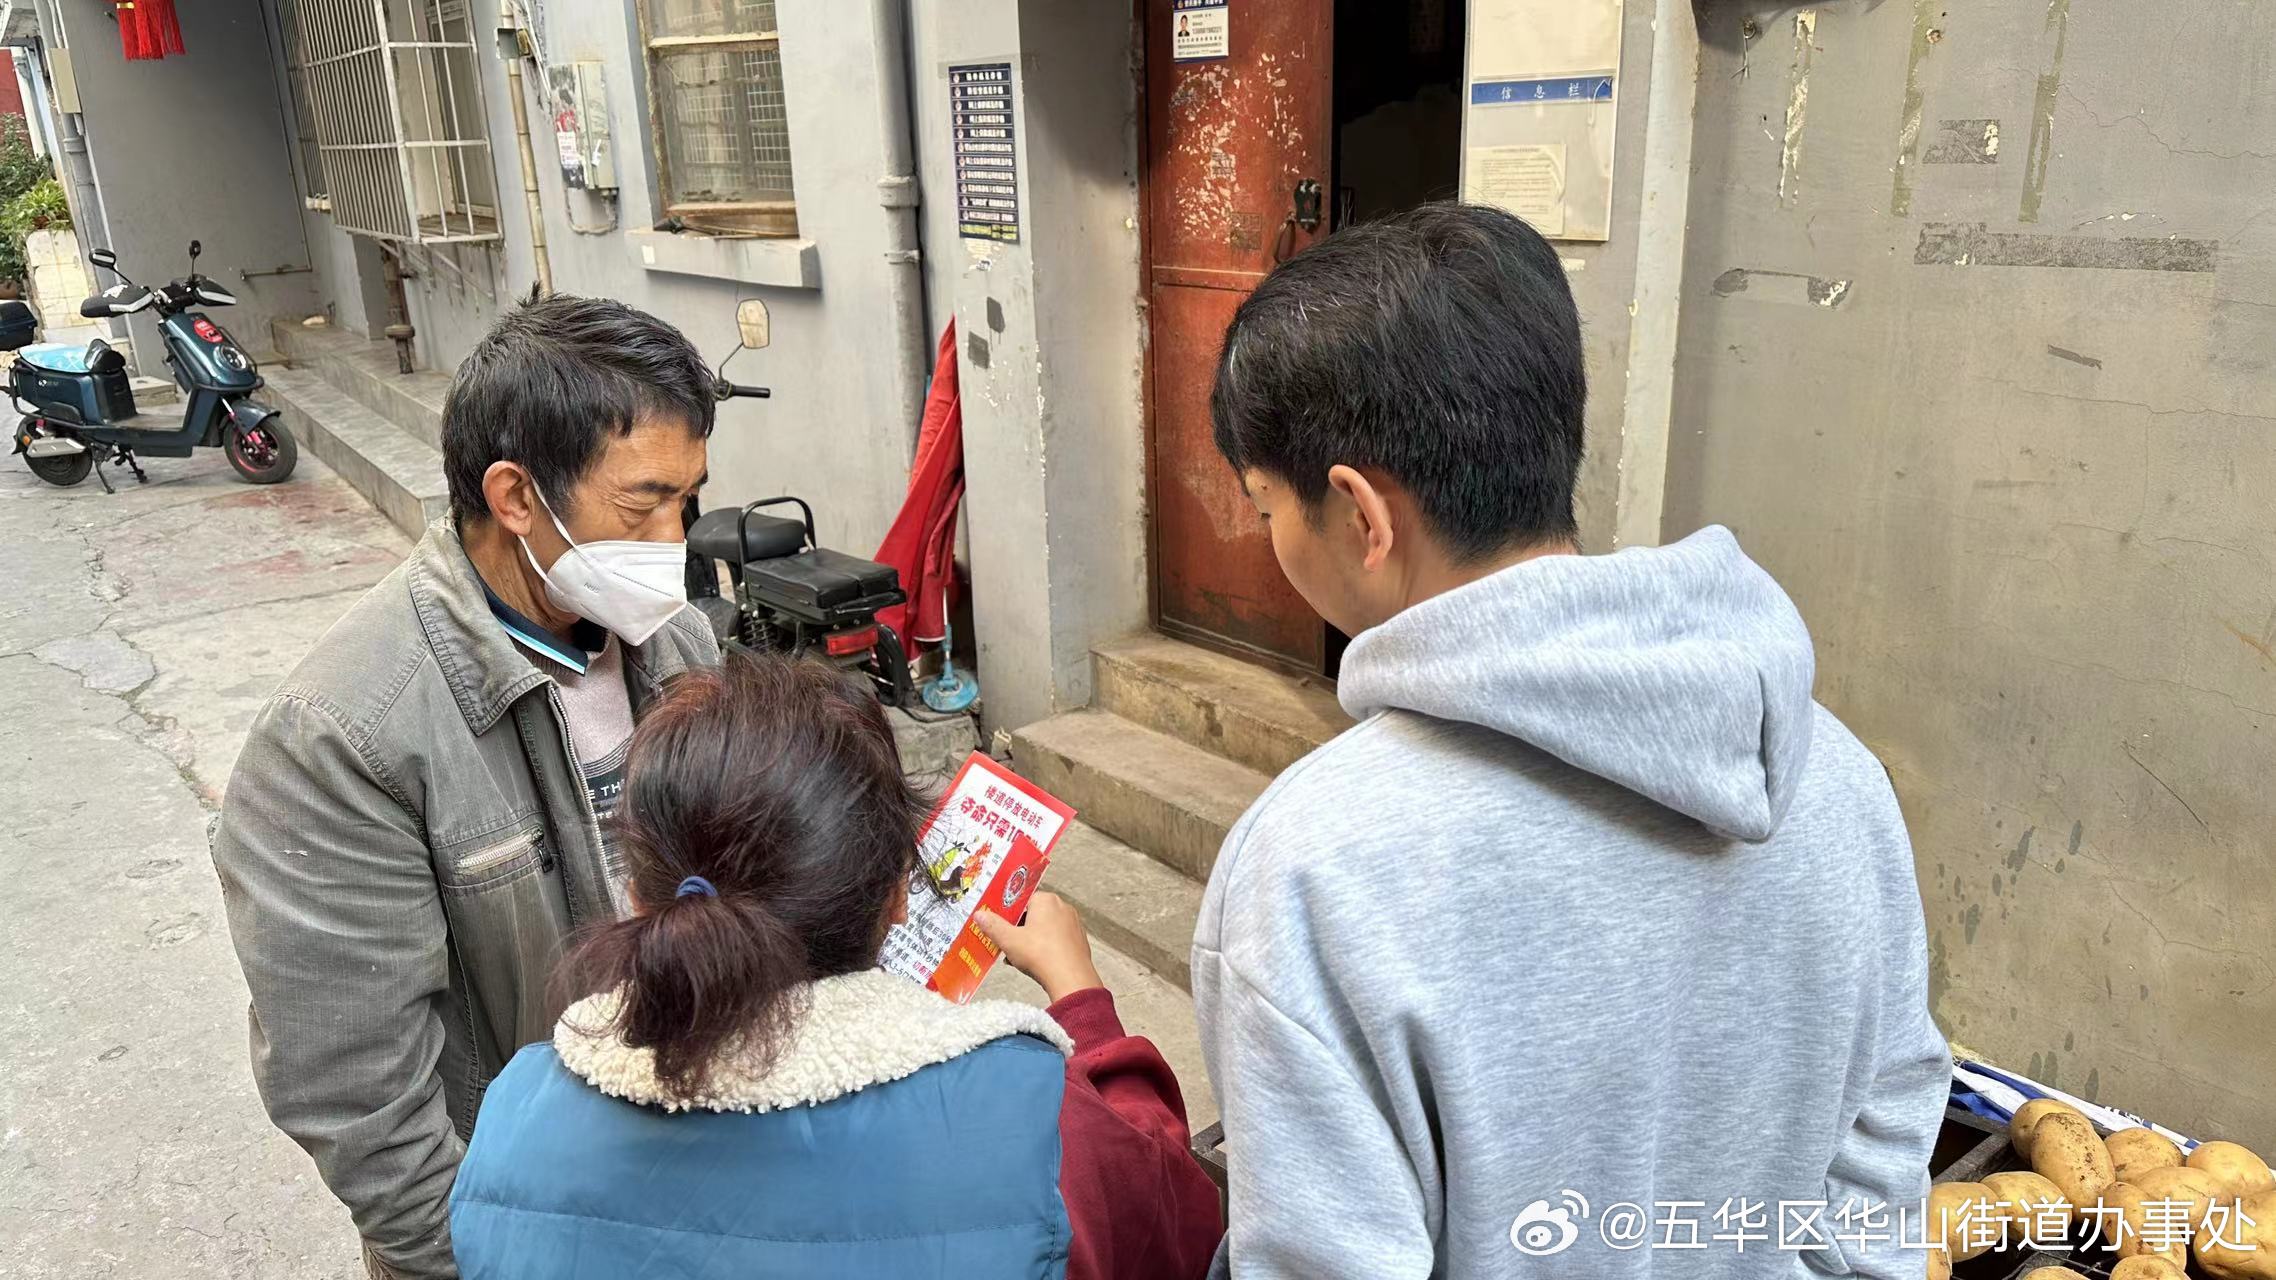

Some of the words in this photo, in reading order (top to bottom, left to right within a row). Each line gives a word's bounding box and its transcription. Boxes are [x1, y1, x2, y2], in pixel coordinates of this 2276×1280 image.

[1501, 82, 1580, 100] 信息栏
[984, 785, 1045, 829] 楼道停放电动车
